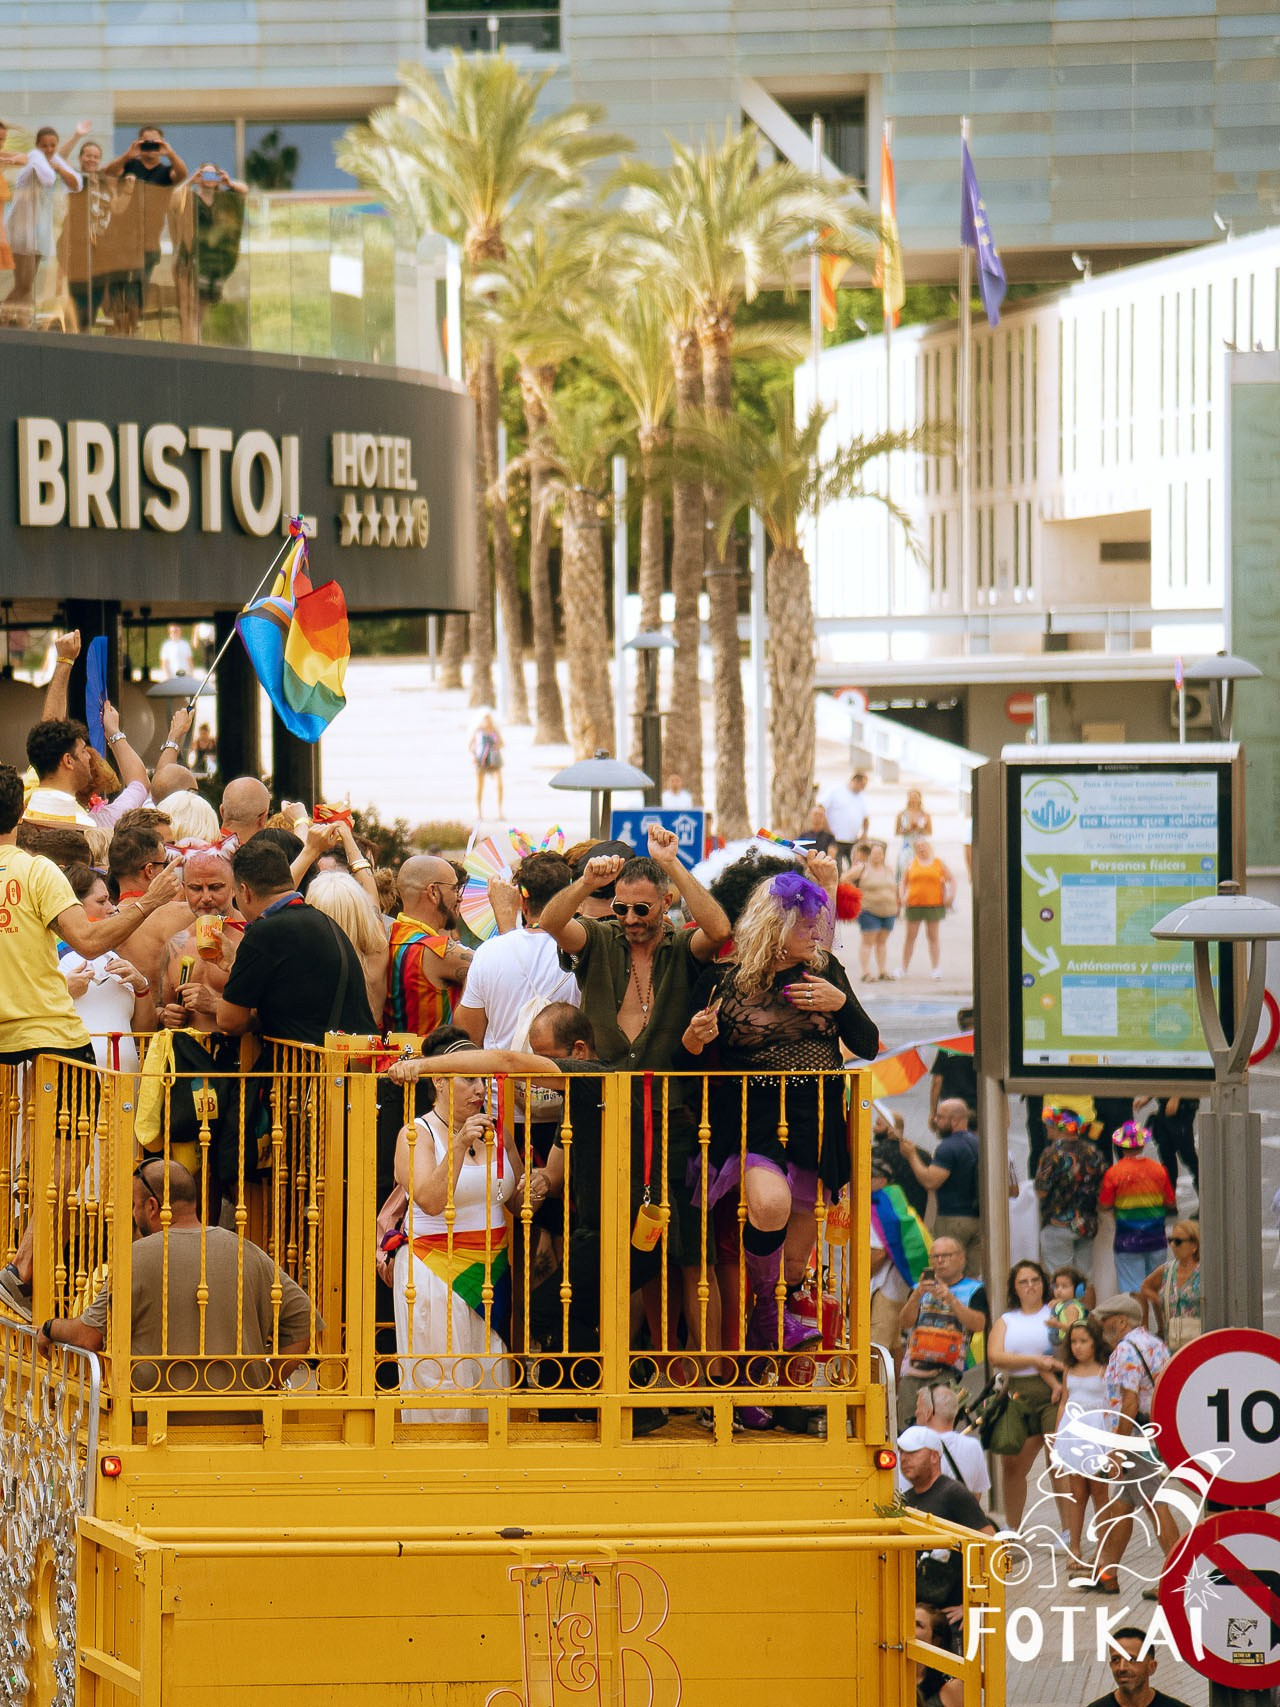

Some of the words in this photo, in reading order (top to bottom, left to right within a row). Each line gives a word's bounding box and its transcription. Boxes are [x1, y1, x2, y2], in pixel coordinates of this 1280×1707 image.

[17, 415, 317, 538] BRISTOL
[331, 431, 417, 491] HOTEL
[1082, 816, 1098, 826] no
[1101, 815, 1138, 826] tienes
[1141, 817, 1165, 828] que
[1168, 814, 1216, 826] solicitar
[1090, 859, 1146, 871] Personas
[1149, 858, 1186, 871] físicas
[1066, 959, 1136, 973] Autónomos
[1140, 963, 1149, 974] y
[1207, 1388, 1280, 1443] 10
